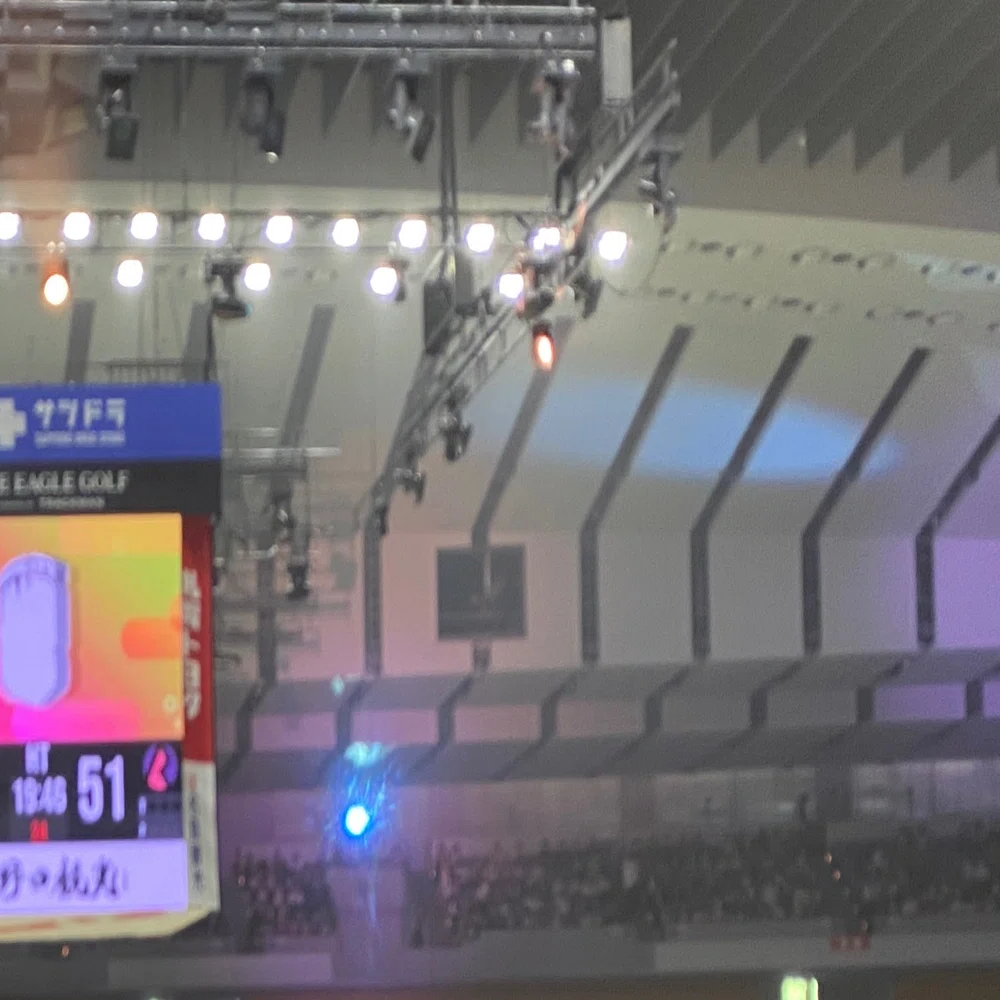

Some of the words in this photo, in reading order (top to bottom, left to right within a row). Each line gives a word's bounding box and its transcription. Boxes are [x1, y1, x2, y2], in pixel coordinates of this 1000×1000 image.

[13, 469, 74, 496] EAGLE
[78, 468, 130, 494] GOLF
[76, 754, 126, 824] 51
